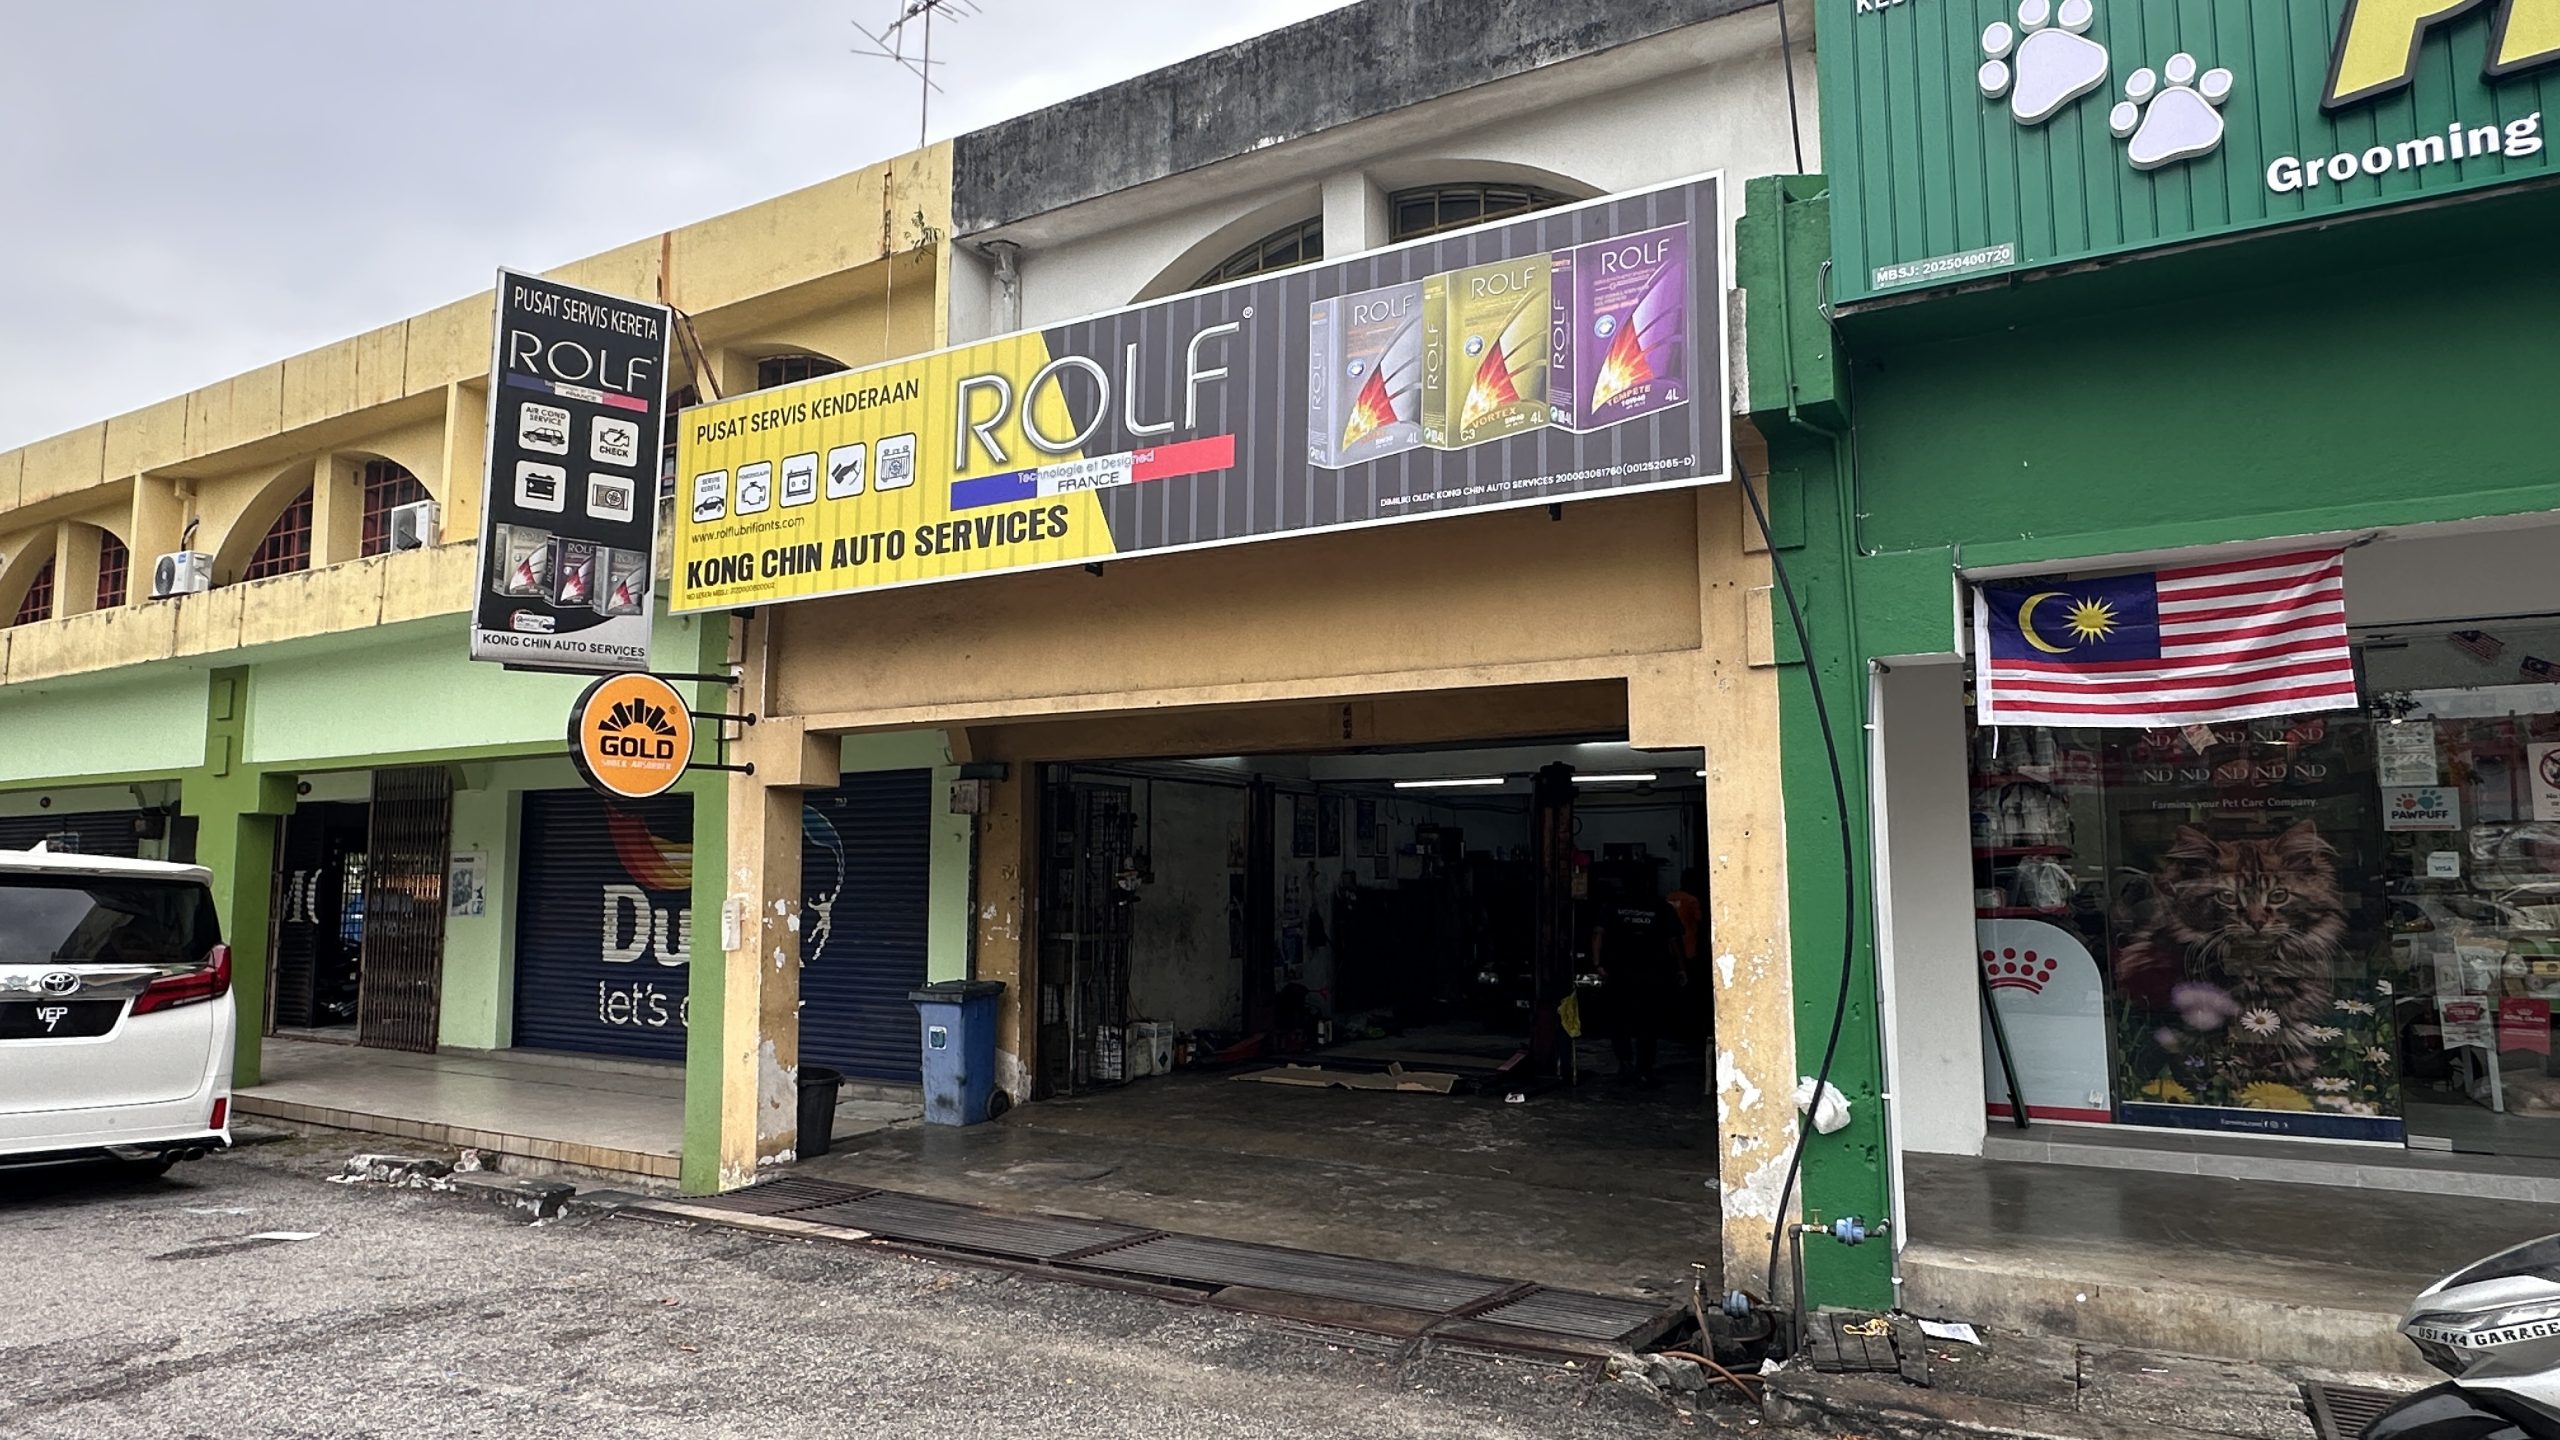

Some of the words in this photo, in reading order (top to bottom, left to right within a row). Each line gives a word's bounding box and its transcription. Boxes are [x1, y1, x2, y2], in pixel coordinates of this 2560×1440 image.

[2266, 111, 2543, 193] Grooming
[1601, 238, 1670, 275] ROLF
[1877, 266, 1919, 283] MBSJ:
[1922, 248, 2010, 274] 20250400720
[1471, 267, 1537, 299] ROLF
[514, 286, 561, 317] PUSAT
[562, 298, 608, 329] SERVIS
[610, 311, 658, 341] KERETA
[1354, 294, 1416, 326] ROLF
[1553, 298, 1566, 369] ROLF
[509, 329, 652, 393] ROLF
[1427, 323, 1439, 389] ROLF
[956, 320, 1240, 471] ROLF
[1665, 388, 1679, 402] 4L
[697, 416, 748, 445] PUSAT
[751, 403, 807, 433] SERVIS
[811, 378, 919, 420] KENDERAAN
[1472, 407, 1517, 429] VORTEX
[1530, 411, 1544, 424] 4L
[1406, 432, 1418, 443] 4L
[1460, 429, 1476, 442] C3
[600, 446, 629, 458] CHECK
[1018, 461, 1083, 484] Technologie
[1086, 459, 1099, 472] et
[1102, 450, 1155, 470] Designed
[1058, 471, 1120, 493] FRANCE
[1436, 488, 1461, 499] KONG
[1463, 485, 1485, 496] CHIN
[1486, 482, 1511, 492] AUTO
[1512, 476, 1554, 489] SERVICES
[691, 516, 805, 543] www.rolflubrifiants.com
[687, 552, 754, 590] KONG
[761, 542, 822, 578] CHIN
[830, 529, 905, 569] AUTO
[914, 504, 1068, 557] SERVICES
[482, 634, 519, 647] KONG
[522, 637, 551, 649] CHIN
[554, 640, 587, 652] AUTO
[589, 643, 645, 657] SERVICES
[2293, 728, 2324, 741] ND
[600, 735, 674, 759] GOLD
[2143, 769, 2173, 784] ND
[2179, 767, 2210, 781] ND
[2217, 766, 2248, 781] ND
[2255, 765, 2287, 780] ND
[2294, 764, 2327, 778] ND
[2197, 801, 2219, 811] your
[2222, 799, 2239, 808] Pet
[2241, 798, 2264, 807] Care
[2267, 796, 2319, 809] Company.
[2391, 810, 2449, 820] PAWPUFF
[36, 1006, 68, 1020] VEP
[599, 980, 668, 1027] let's
[45, 1020, 57, 1032] 7
[2418, 1327, 2439, 1340] USJ
[2441, 1333, 2468, 1347] 4X4
